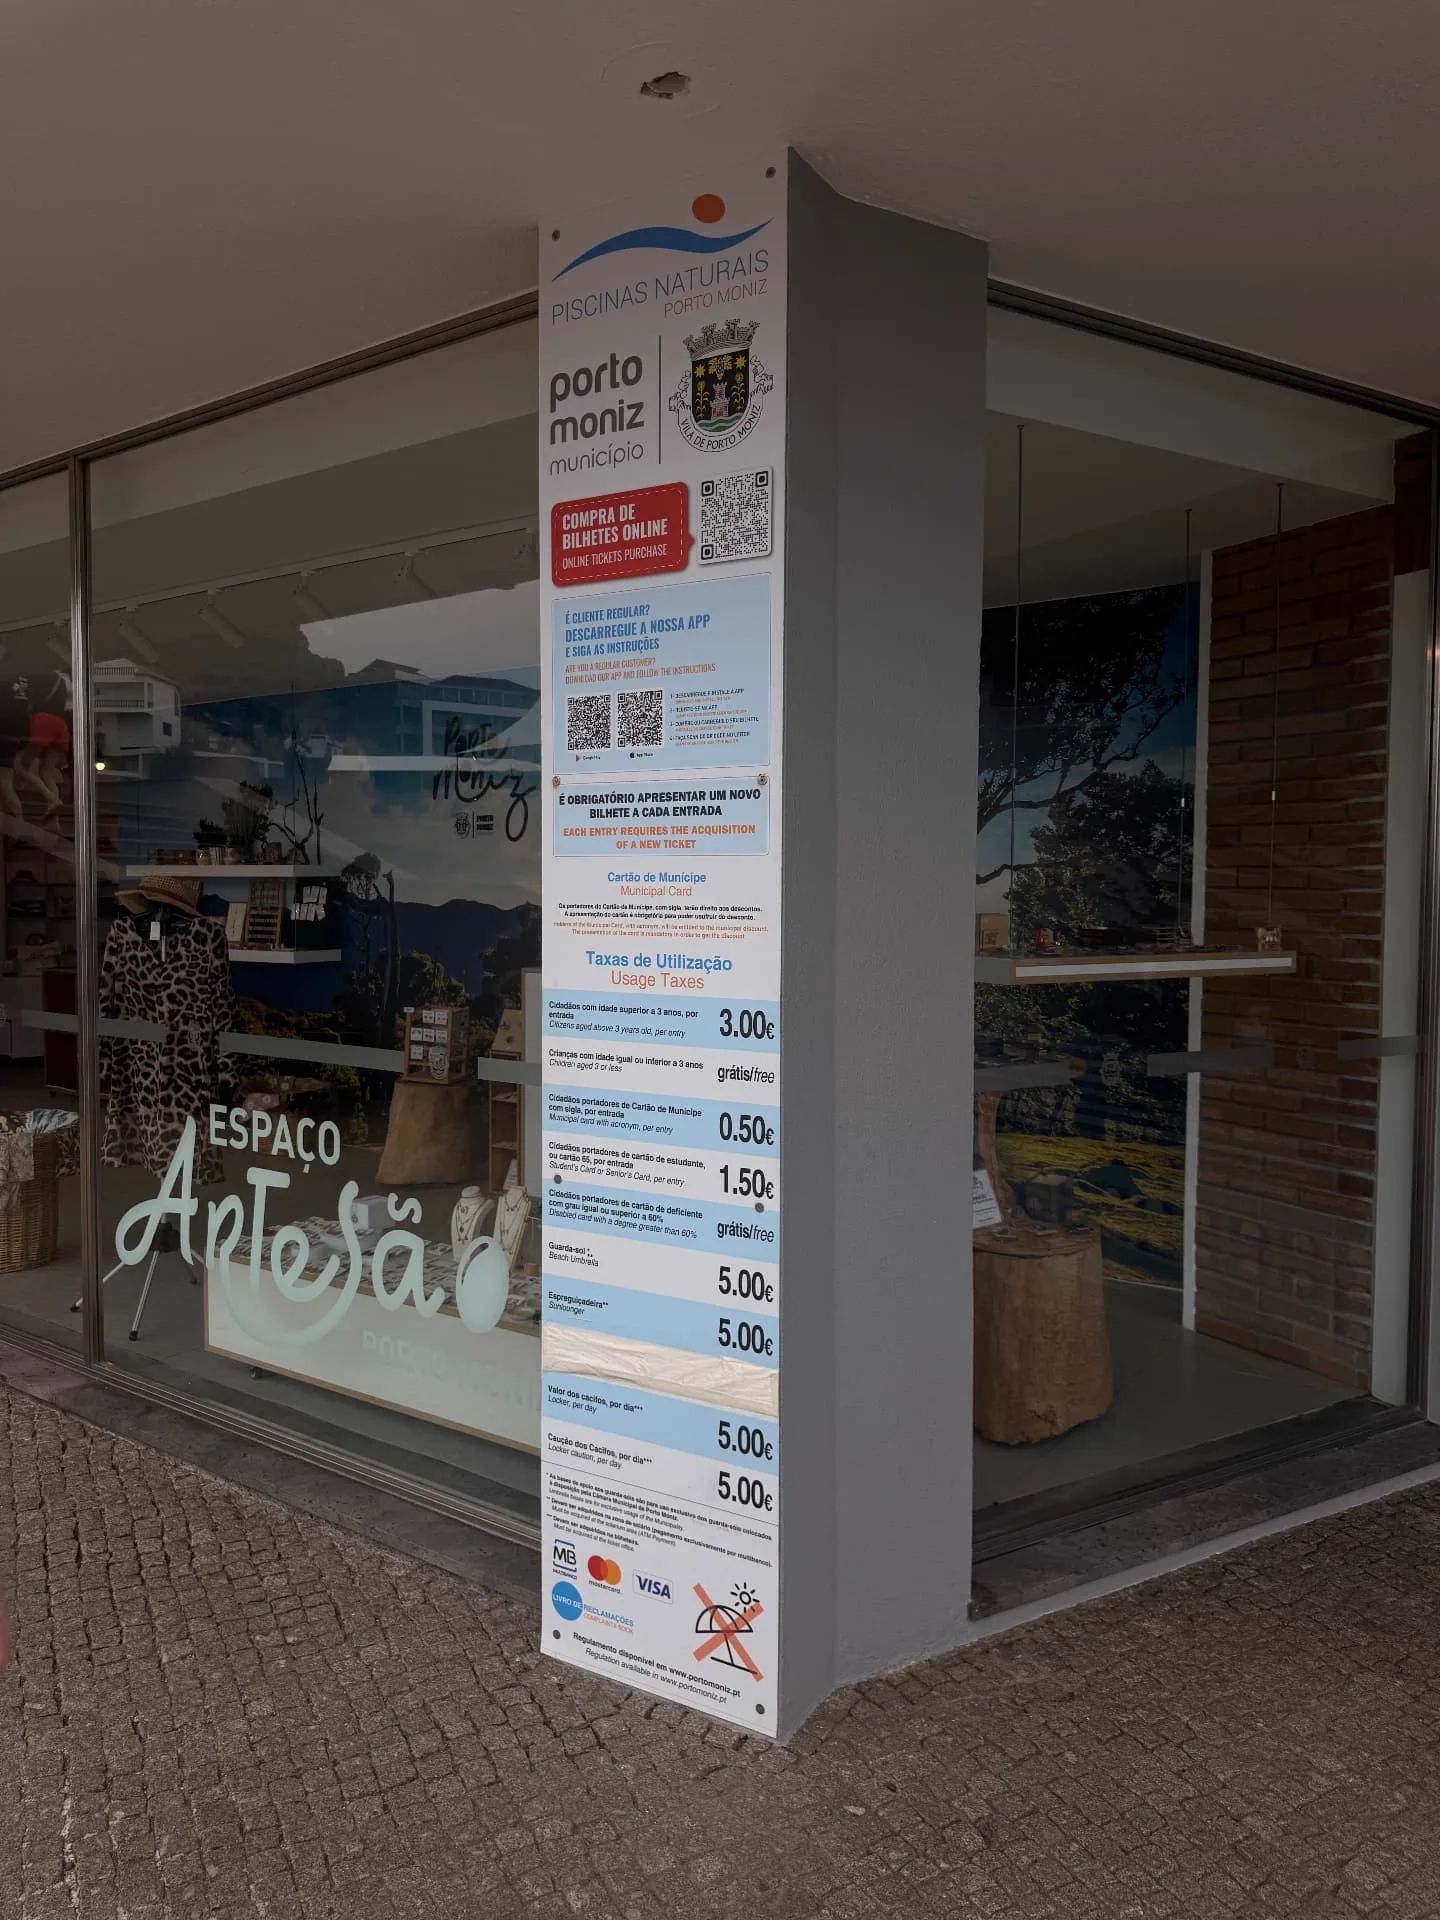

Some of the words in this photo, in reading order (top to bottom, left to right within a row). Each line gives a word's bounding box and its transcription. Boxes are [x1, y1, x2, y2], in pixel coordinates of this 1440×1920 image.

[552, 281, 648, 326] PISCINAS
[655, 249, 769, 299] NATURAIS
[664, 292, 713, 318] PORTO
[717, 278, 768, 305] MONIZ
[550, 353, 643, 413] porto
[550, 399, 645, 445] moniz
[680, 418, 694, 441] VILA
[706, 434, 736, 450] PORTO
[737, 404, 761, 439] MONIZ
[550, 441, 644, 476] município
[562, 506, 615, 530] COMPRA
[619, 503, 636, 522] DE
[562, 526, 619, 550] BILHETES
[622, 518, 668, 541] ONLINE
[562, 555, 589, 570] ONLINE
[592, 550, 623, 565] TICKETS
[624, 543, 668, 560] PURCHASE
[565, 609, 572, 624] É
[572, 610, 605, 624] CLIENTE
[606, 604, 651, 619] REGULAR?
[565, 622, 637, 643] DESCARREGUE
[640, 621, 647, 635] A
[650, 617, 684, 634] NOSSA
[687, 613, 711, 630] APP
[565, 646, 571, 658] E
[572, 643, 592, 657] SIGA
[594, 642, 605, 656] AS
[606, 636, 660, 654] INSTRUÇÕES
[559, 793, 565, 806] É
[567, 791, 635, 805] OBRIGATÓRIO
[637, 790, 707, 803] APRESENTAR
[709, 789, 726, 801] UM
[729, 788, 761, 800] NOVO
[589, 807, 631, 819] BILHETE
[632, 807, 639, 818] A
[641, 806, 670, 818] CADA
[672, 805, 722, 817] ENTRADA
[563, 827, 587, 837] EACH
[589, 826, 617, 837] ENTRY
[620, 825, 668, 837] REQUIRES
[671, 825, 689, 835] THE
[691, 823, 756, 836] ACQUISITION
[615, 840, 629, 849] OF
[630, 840, 637, 849] A
[639, 840, 661, 849] NEW
[663, 839, 697, 849] TICKET
[607, 871, 641, 882] Cartão
[643, 872, 656, 883] de
[620, 885, 666, 898] Municipal
[668, 885, 692, 897] Card
[585, 950, 629, 967] Taxas
[633, 952, 652, 967] de
[656, 953, 733, 975] Utilização
[611, 970, 656, 989] Usage
[660, 972, 705, 989] Taxes
[548, 1000, 581, 1010] Cidadãos
[598, 1003, 618, 1013] idade
[619, 1005, 650, 1015] superior
[663, 1009, 684, 1018] anos,
[685, 1010, 699, 1019] por
[548, 1012, 574, 1020] entrada
[719, 1008, 775, 1040] 3.00€
[548, 1049, 579, 1060] Crianças
[579, 1052, 595, 1060] com
[595, 1052, 615, 1062] idade
[615, 1054, 634, 1064] igual
[645, 1056, 672, 1067] inferior
[685, 1061, 704, 1070] anos
[717, 1065, 775, 1084] grátis/free
[548, 1093, 581, 1104] Cidadãos
[581, 1098, 620, 1109] portadores
[621, 1101, 631, 1109] de
[631, 1102, 656, 1113] Cartão
[657, 1105, 667, 1113] de
[584, 1108, 597, 1116] por
[597, 1110, 625, 1119] entrada
[209, 1103, 341, 1173] ESPAÇO
[719, 1111, 775, 1146] 0.50€
[548, 1141, 581, 1153] Cidadãos
[581, 1147, 620, 1158] portadores
[620, 1150, 631, 1159] de
[631, 1152, 655, 1161] cartão
[655, 1154, 666, 1163] de
[666, 1156, 706, 1170] estudante,
[559, 1153, 581, 1161] cartão
[593, 1158, 606, 1166] por
[606, 1160, 634, 1169] entrada
[719, 1164, 775, 1200] 1.50€
[548, 1188, 581, 1201] Cidadãos
[581, 1194, 620, 1206] portadores
[620, 1199, 631, 1208] de
[631, 1201, 655, 1211] cartão
[655, 1205, 666, 1214] de
[666, 1206, 703, 1219] deficiente
[548, 1199, 564, 1207] com
[564, 1201, 581, 1210] grau
[581, 1204, 599, 1213] igual
[610, 1208, 641, 1220] superior
[717, 1221, 775, 1243] grátis/free
[548, 1241, 586, 1255] Guarda-sol
[548, 1251, 569, 1262] Beach
[718, 1265, 774, 1303] 5.00€
[717, 1317, 774, 1357] 5.00€
[548, 1384, 566, 1396] Valor
[566, 1389, 580, 1398] dos
[609, 1401, 623, 1410] por
[584, 1404, 598, 1415] day
[547, 1432, 574, 1446] Caução
[574, 1440, 588, 1450] dos
[618, 1452, 632, 1462] por
[717, 1420, 774, 1461] 5.00€
[609, 1459, 623, 1470] day
[717, 1470, 773, 1512] 5.00€
[553, 1545, 577, 1565] MB
[552, 1593, 573, 1606] LIVRO
[636, 1574, 671, 1600] VISA
[573, 1631, 617, 1655] Regulamento
[656, 1662, 668, 1672] em
[669, 1667, 741, 1697] www.portomoniz.pt
[585, 1647, 621, 1667] Regulation
[620, 1660, 651, 1676] available
[659, 1675, 728, 1705] www.portomoniz.pt
